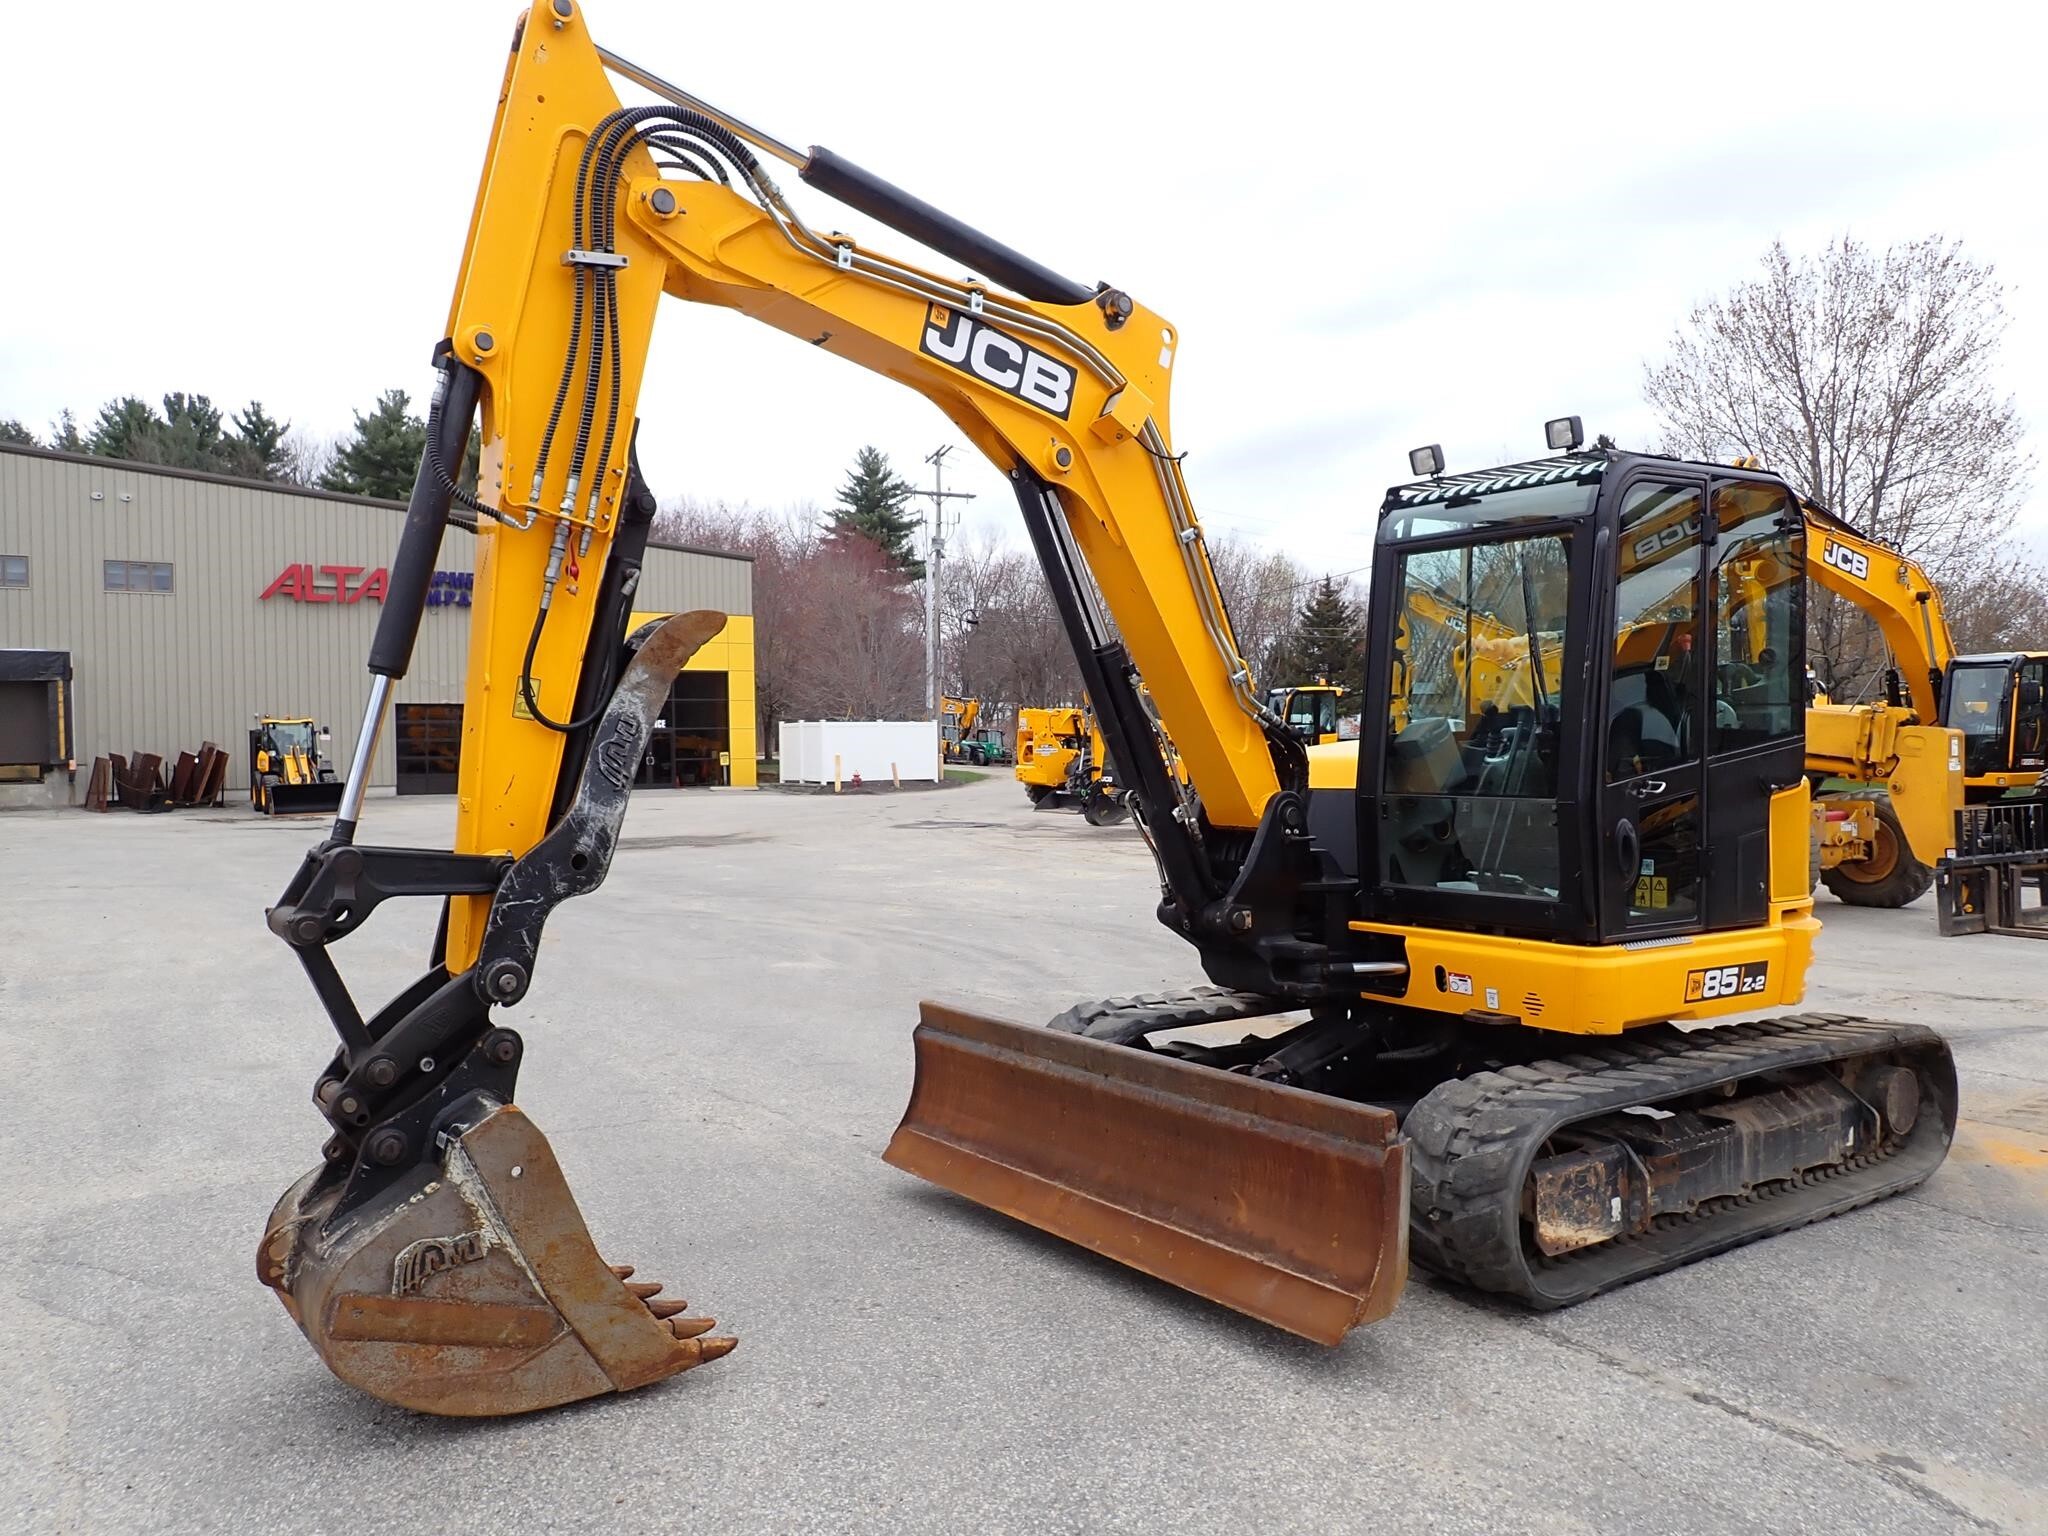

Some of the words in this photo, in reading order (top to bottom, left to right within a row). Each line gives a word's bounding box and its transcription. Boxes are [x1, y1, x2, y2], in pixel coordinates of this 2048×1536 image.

[925, 316, 1071, 413] JCB
[1824, 543, 1868, 579] JCB
[258, 563, 388, 605] ALTA
[1703, 967, 1739, 998] 85
